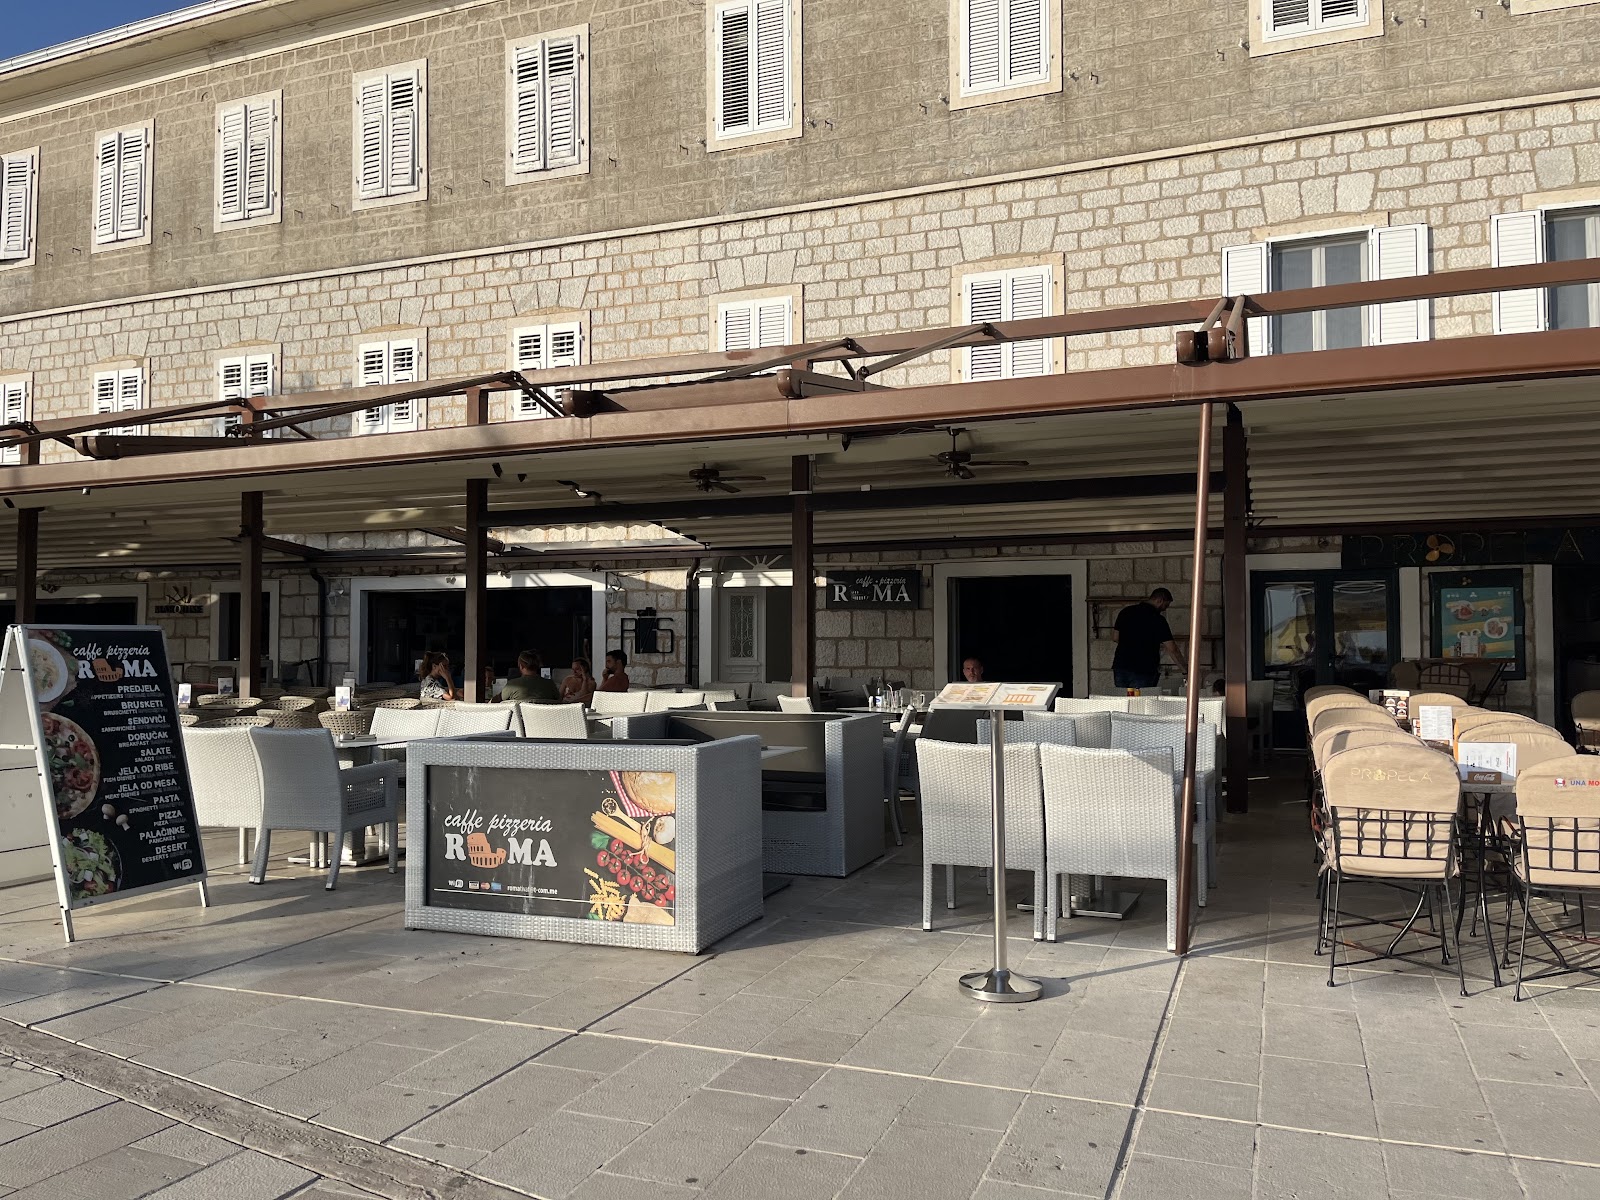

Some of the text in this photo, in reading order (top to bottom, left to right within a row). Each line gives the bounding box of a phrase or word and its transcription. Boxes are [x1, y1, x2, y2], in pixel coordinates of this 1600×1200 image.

[73, 643, 150, 660] caffe pizzeria
[118, 684, 160, 693] PREDJELA
[121, 700, 163, 709] BRUSKETI
[140, 747, 171, 756] SALATE
[118, 766, 140, 776] JELA
[154, 762, 174, 772] RIBE
[118, 783, 139, 792] JELA
[140, 782, 152, 790] OD
[154, 778, 177, 788] MESA
[153, 794, 180, 804] PASTA
[158, 810, 182, 820] PIZZA
[444, 809, 553, 837] caffe pizzeria
[155, 842, 188, 854] DESERT
[142, 854, 169, 863] DESSERTS
